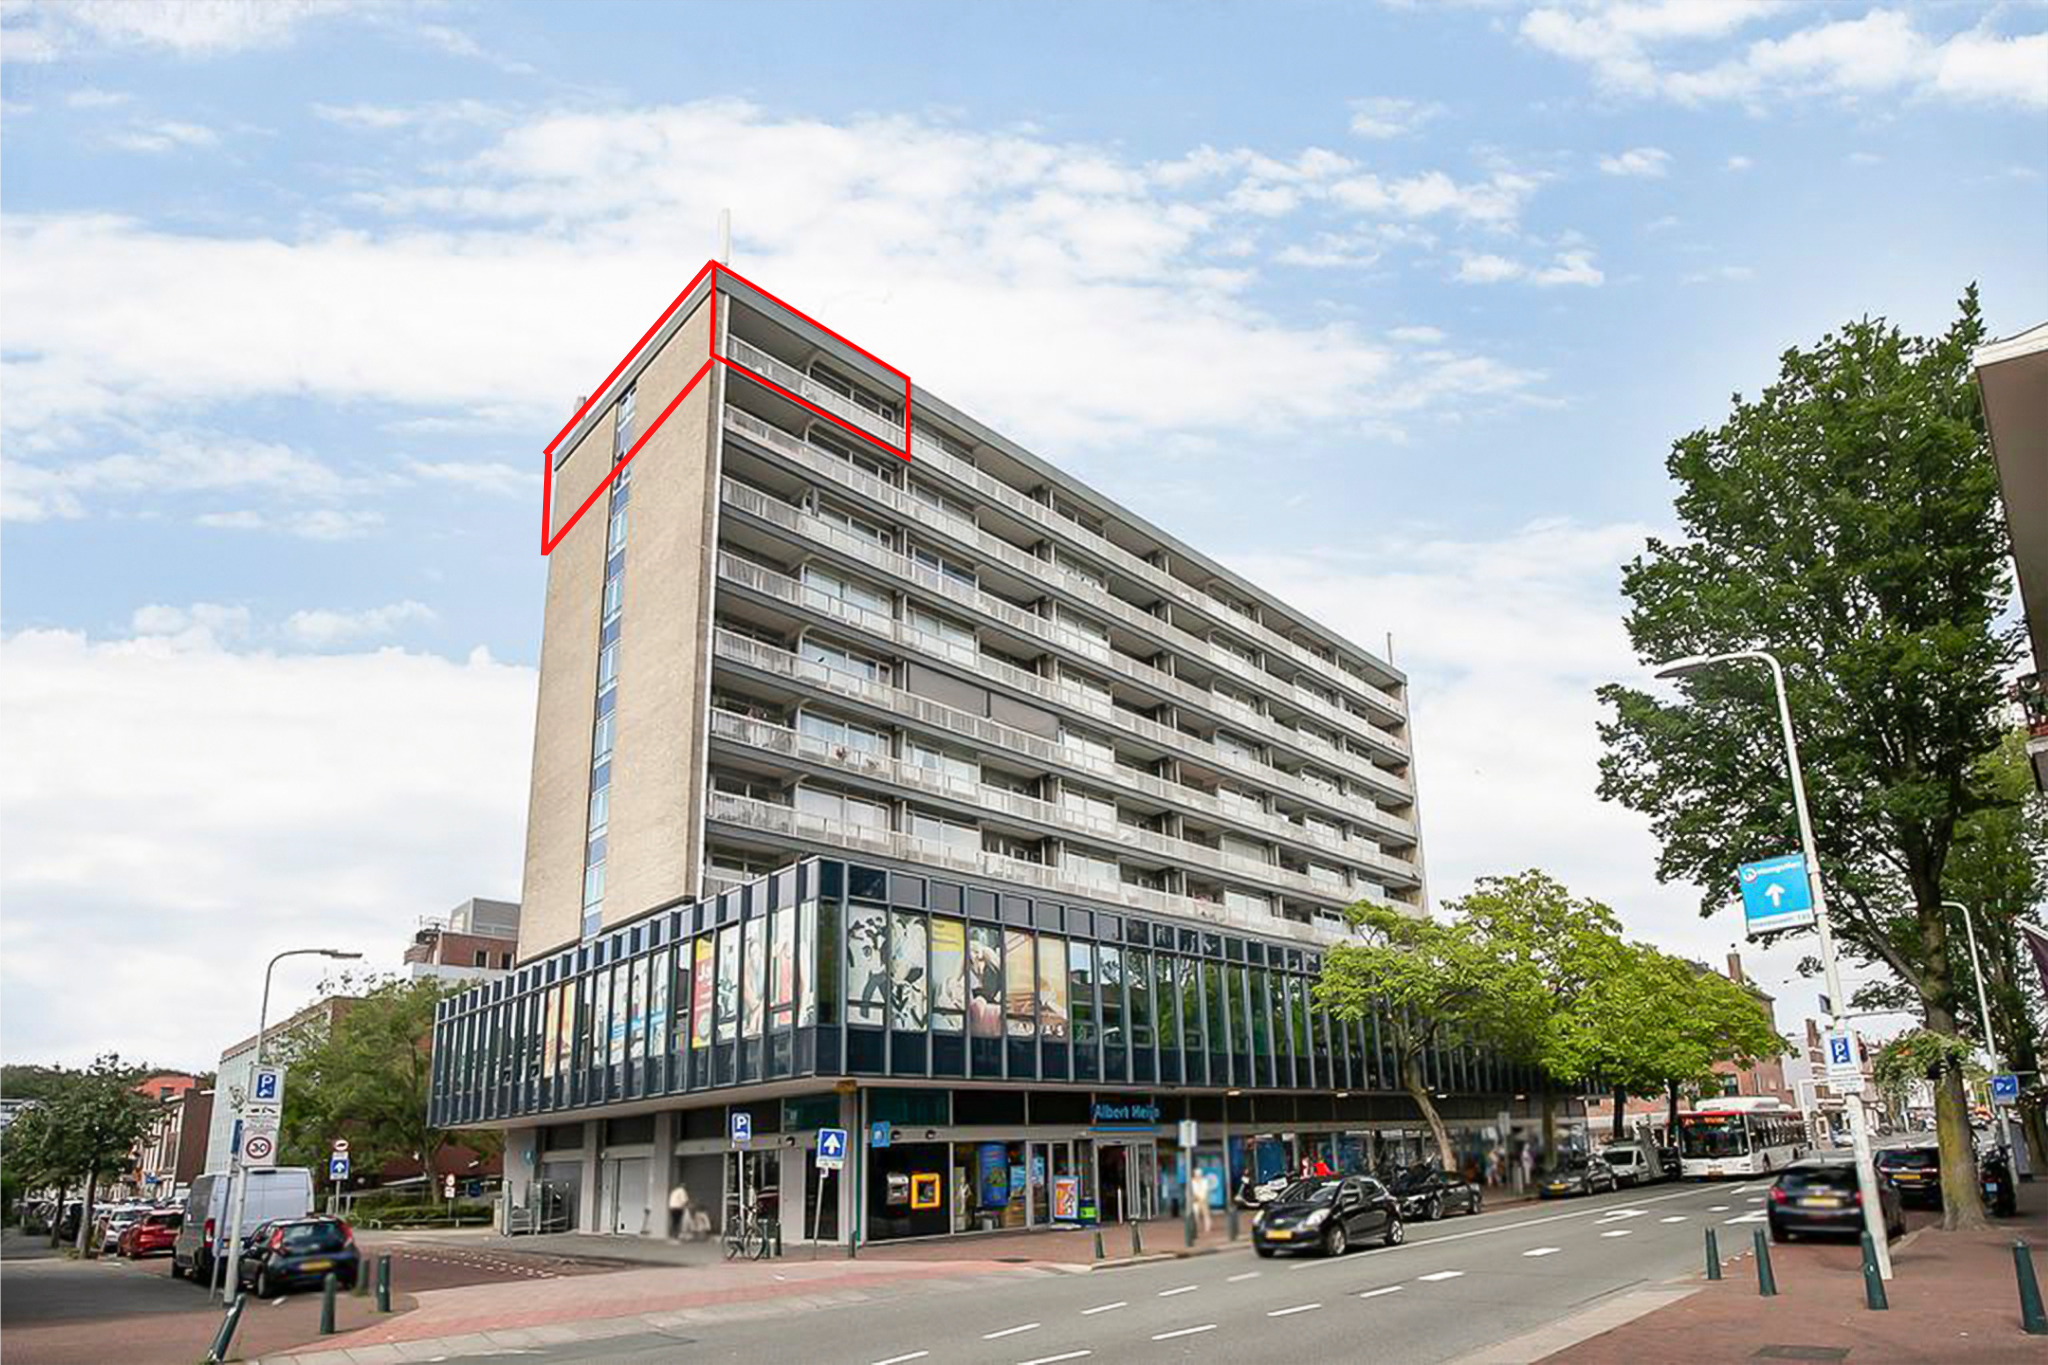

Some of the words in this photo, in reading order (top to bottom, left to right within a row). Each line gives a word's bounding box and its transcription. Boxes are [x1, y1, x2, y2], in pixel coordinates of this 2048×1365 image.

[1835, 1042, 1846, 1056] P
[260, 1075, 274, 1089] P
[1094, 1104, 1129, 1119] Albert
[736, 1116, 748, 1130] P
[250, 1143, 267, 1154] 30
